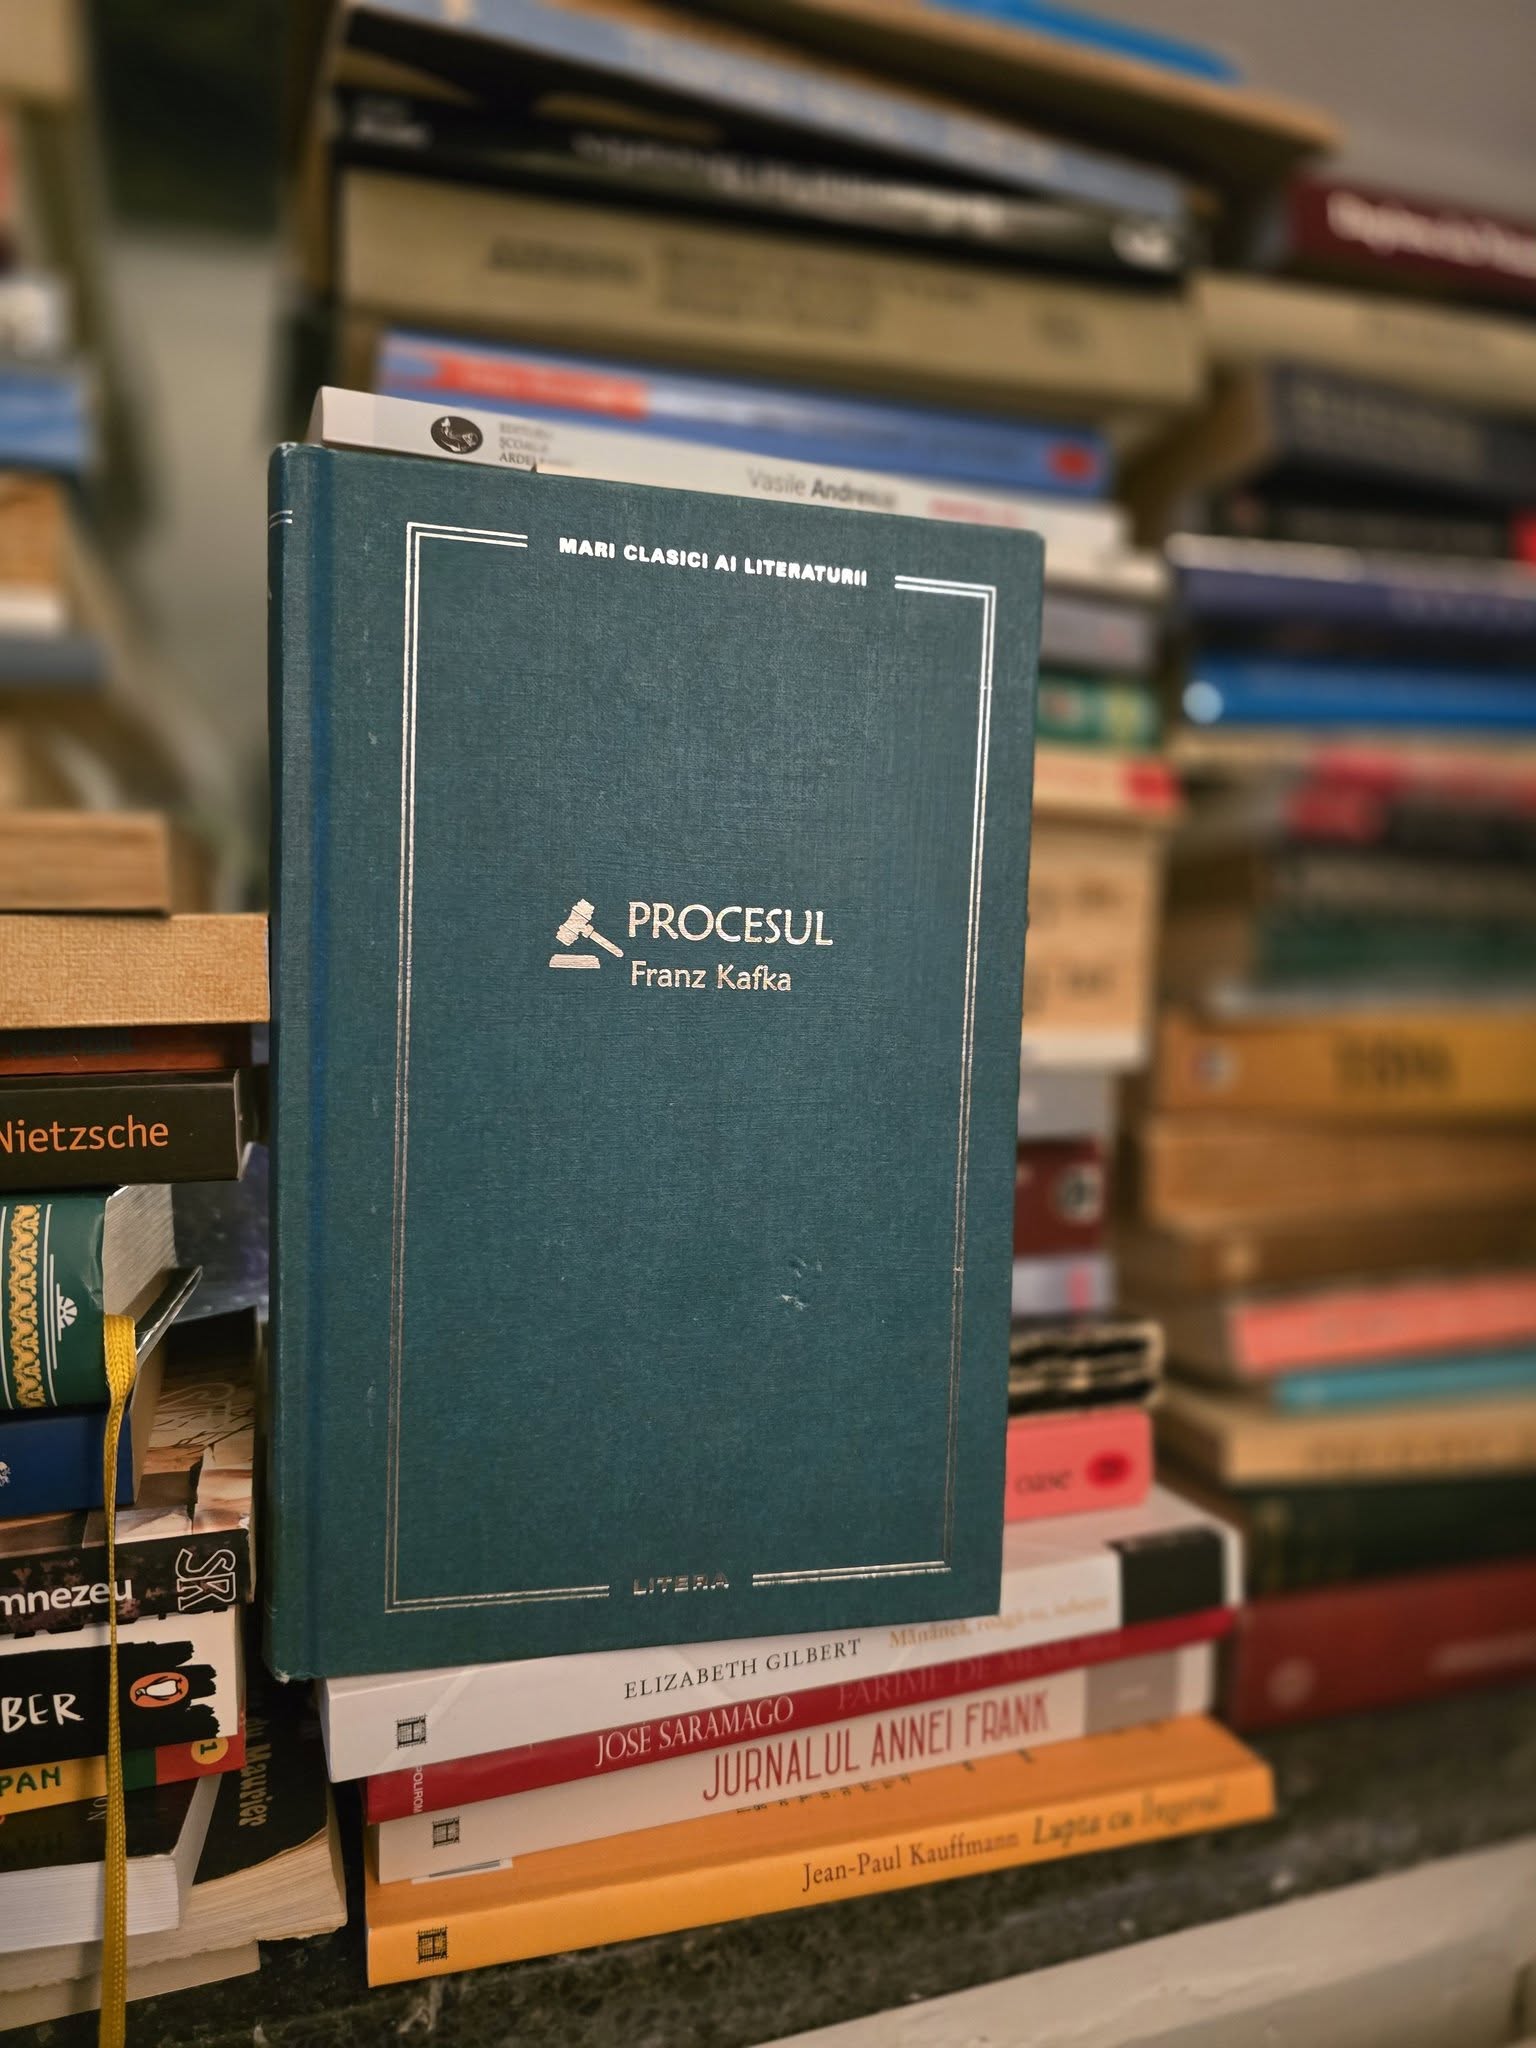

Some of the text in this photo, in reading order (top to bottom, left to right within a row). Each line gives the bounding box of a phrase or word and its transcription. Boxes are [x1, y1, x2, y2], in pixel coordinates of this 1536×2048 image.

[559, 537, 867, 587] MARI CLASICI AI LITERATURII
[628, 901, 834, 946] PROCESUL
[631, 960, 792, 991] Franz Kafka
[0, 1114, 169, 1153] Nietzsche
[633, 1571, 730, 1596] LITERA
[624, 1657, 757, 1700] ELIZABETH
[766, 1637, 862, 1671] GILBERT
[1, 1693, 84, 1733] BER
[658, 1695, 794, 1749] SARAMAGO
[703, 1727, 861, 1802] JURNALUL
[871, 1708, 952, 1767] ANNEI
[965, 1690, 1049, 1747] FRANK
[802, 1845, 902, 1893] Jean-Paul
[909, 1831, 1019, 1867] Kauffmann
